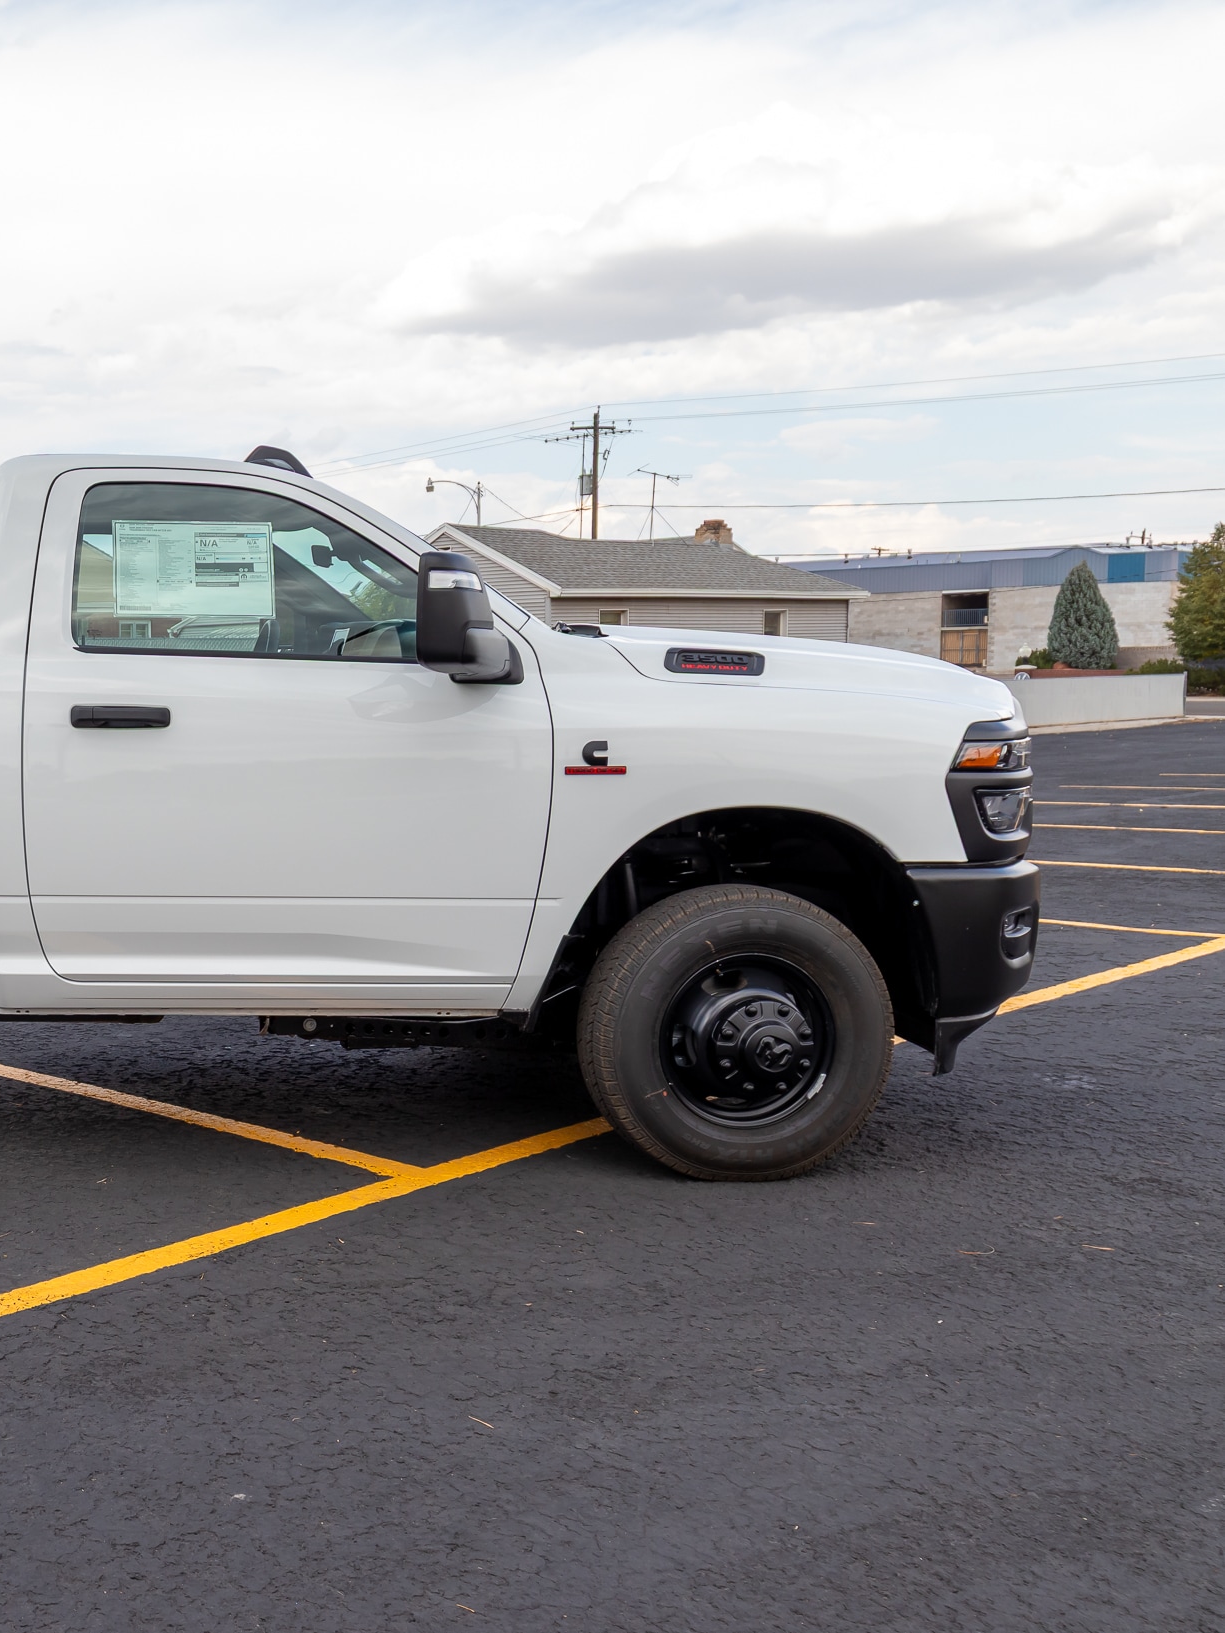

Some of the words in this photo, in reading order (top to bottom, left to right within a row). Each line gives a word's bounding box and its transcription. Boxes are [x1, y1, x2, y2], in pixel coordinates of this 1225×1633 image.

[199, 539, 218, 547] N/A
[681, 653, 749, 665] 3500
[639, 917, 779, 1000] NEXEN
